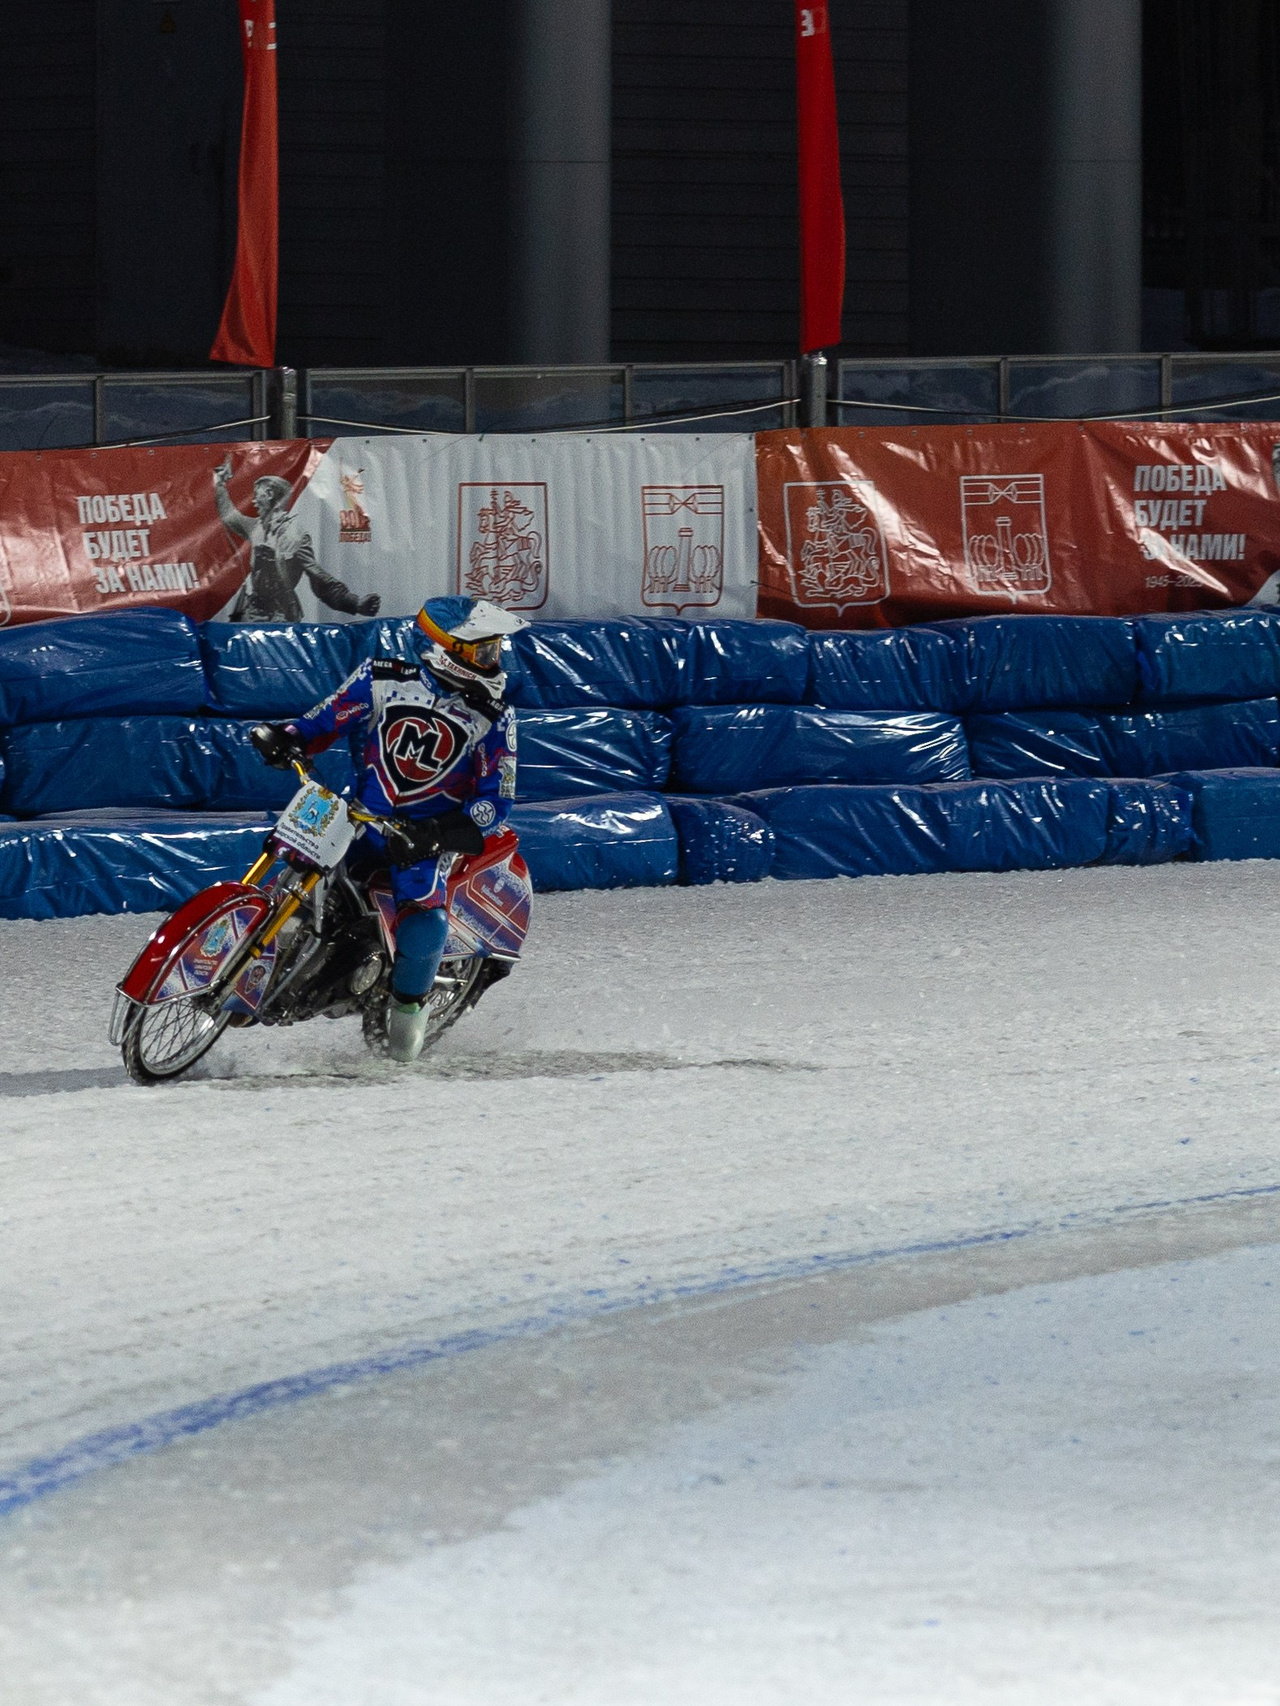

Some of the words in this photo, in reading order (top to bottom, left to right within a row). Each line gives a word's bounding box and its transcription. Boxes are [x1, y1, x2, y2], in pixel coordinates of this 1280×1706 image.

[1133, 464, 1228, 496] ПОБЕДА
[77, 492, 168, 526] ПОБЕДА
[1134, 499, 1208, 531] БУДЕТ
[82, 528, 151, 562] БУДЕТ
[90, 566, 126, 593] ЗА
[124, 562, 201, 592] НАМИ!
